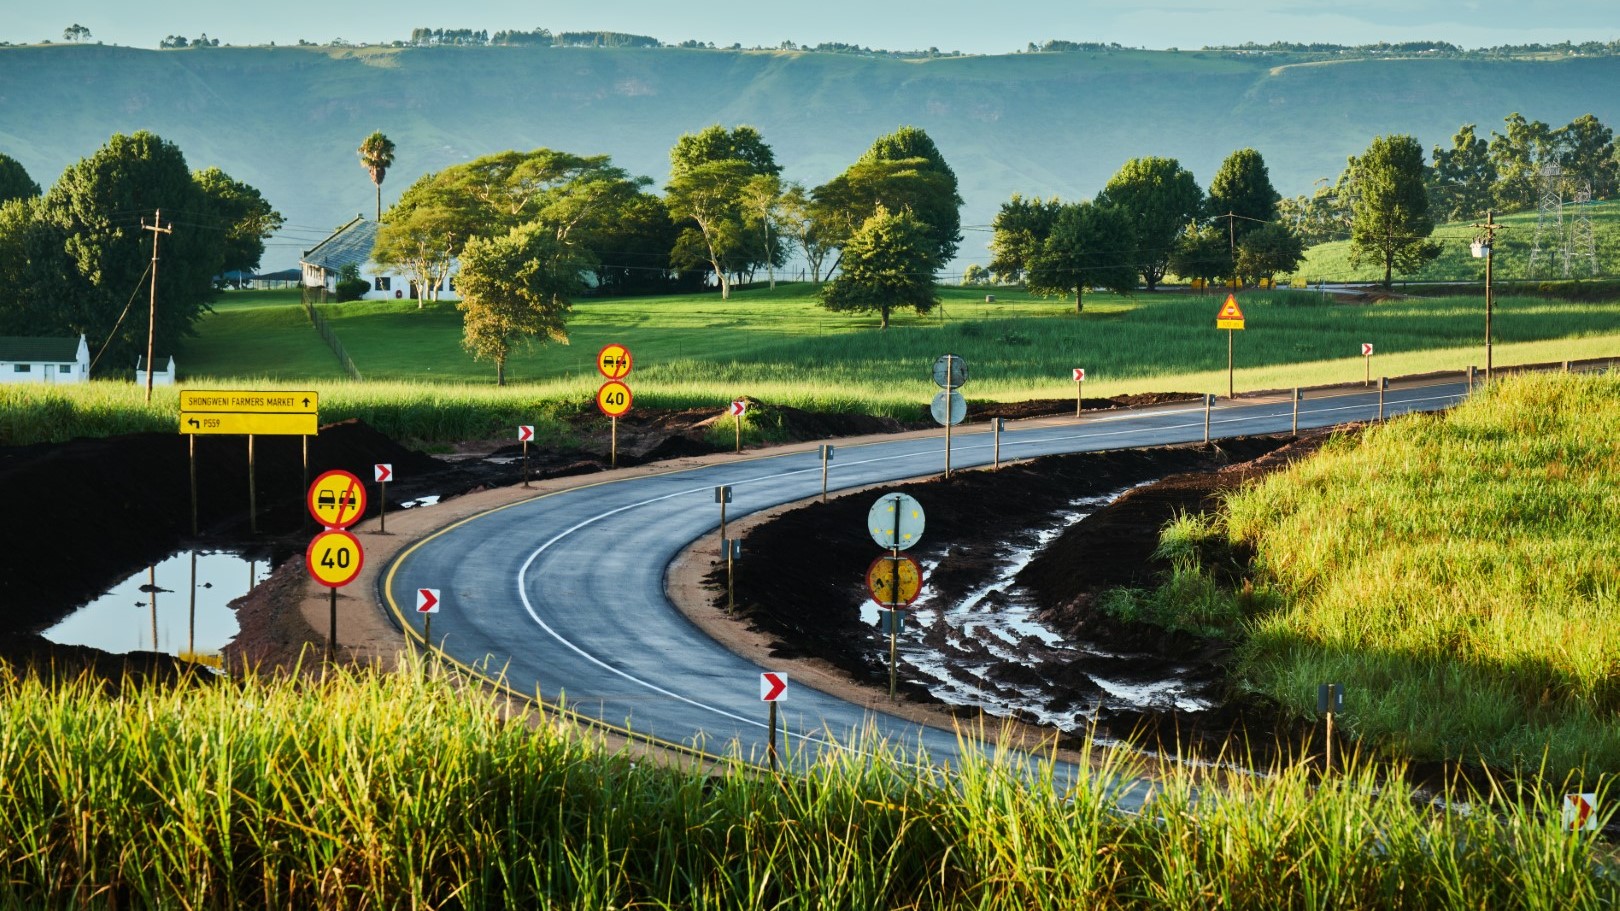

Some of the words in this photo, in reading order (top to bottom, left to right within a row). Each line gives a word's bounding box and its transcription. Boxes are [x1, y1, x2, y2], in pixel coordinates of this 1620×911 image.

[188, 396, 229, 406] SHONGWENI
[231, 397, 264, 406] FARMERS
[266, 397, 295, 407] MARKET
[605, 392, 624, 405] 40
[320, 547, 350, 569] 40
